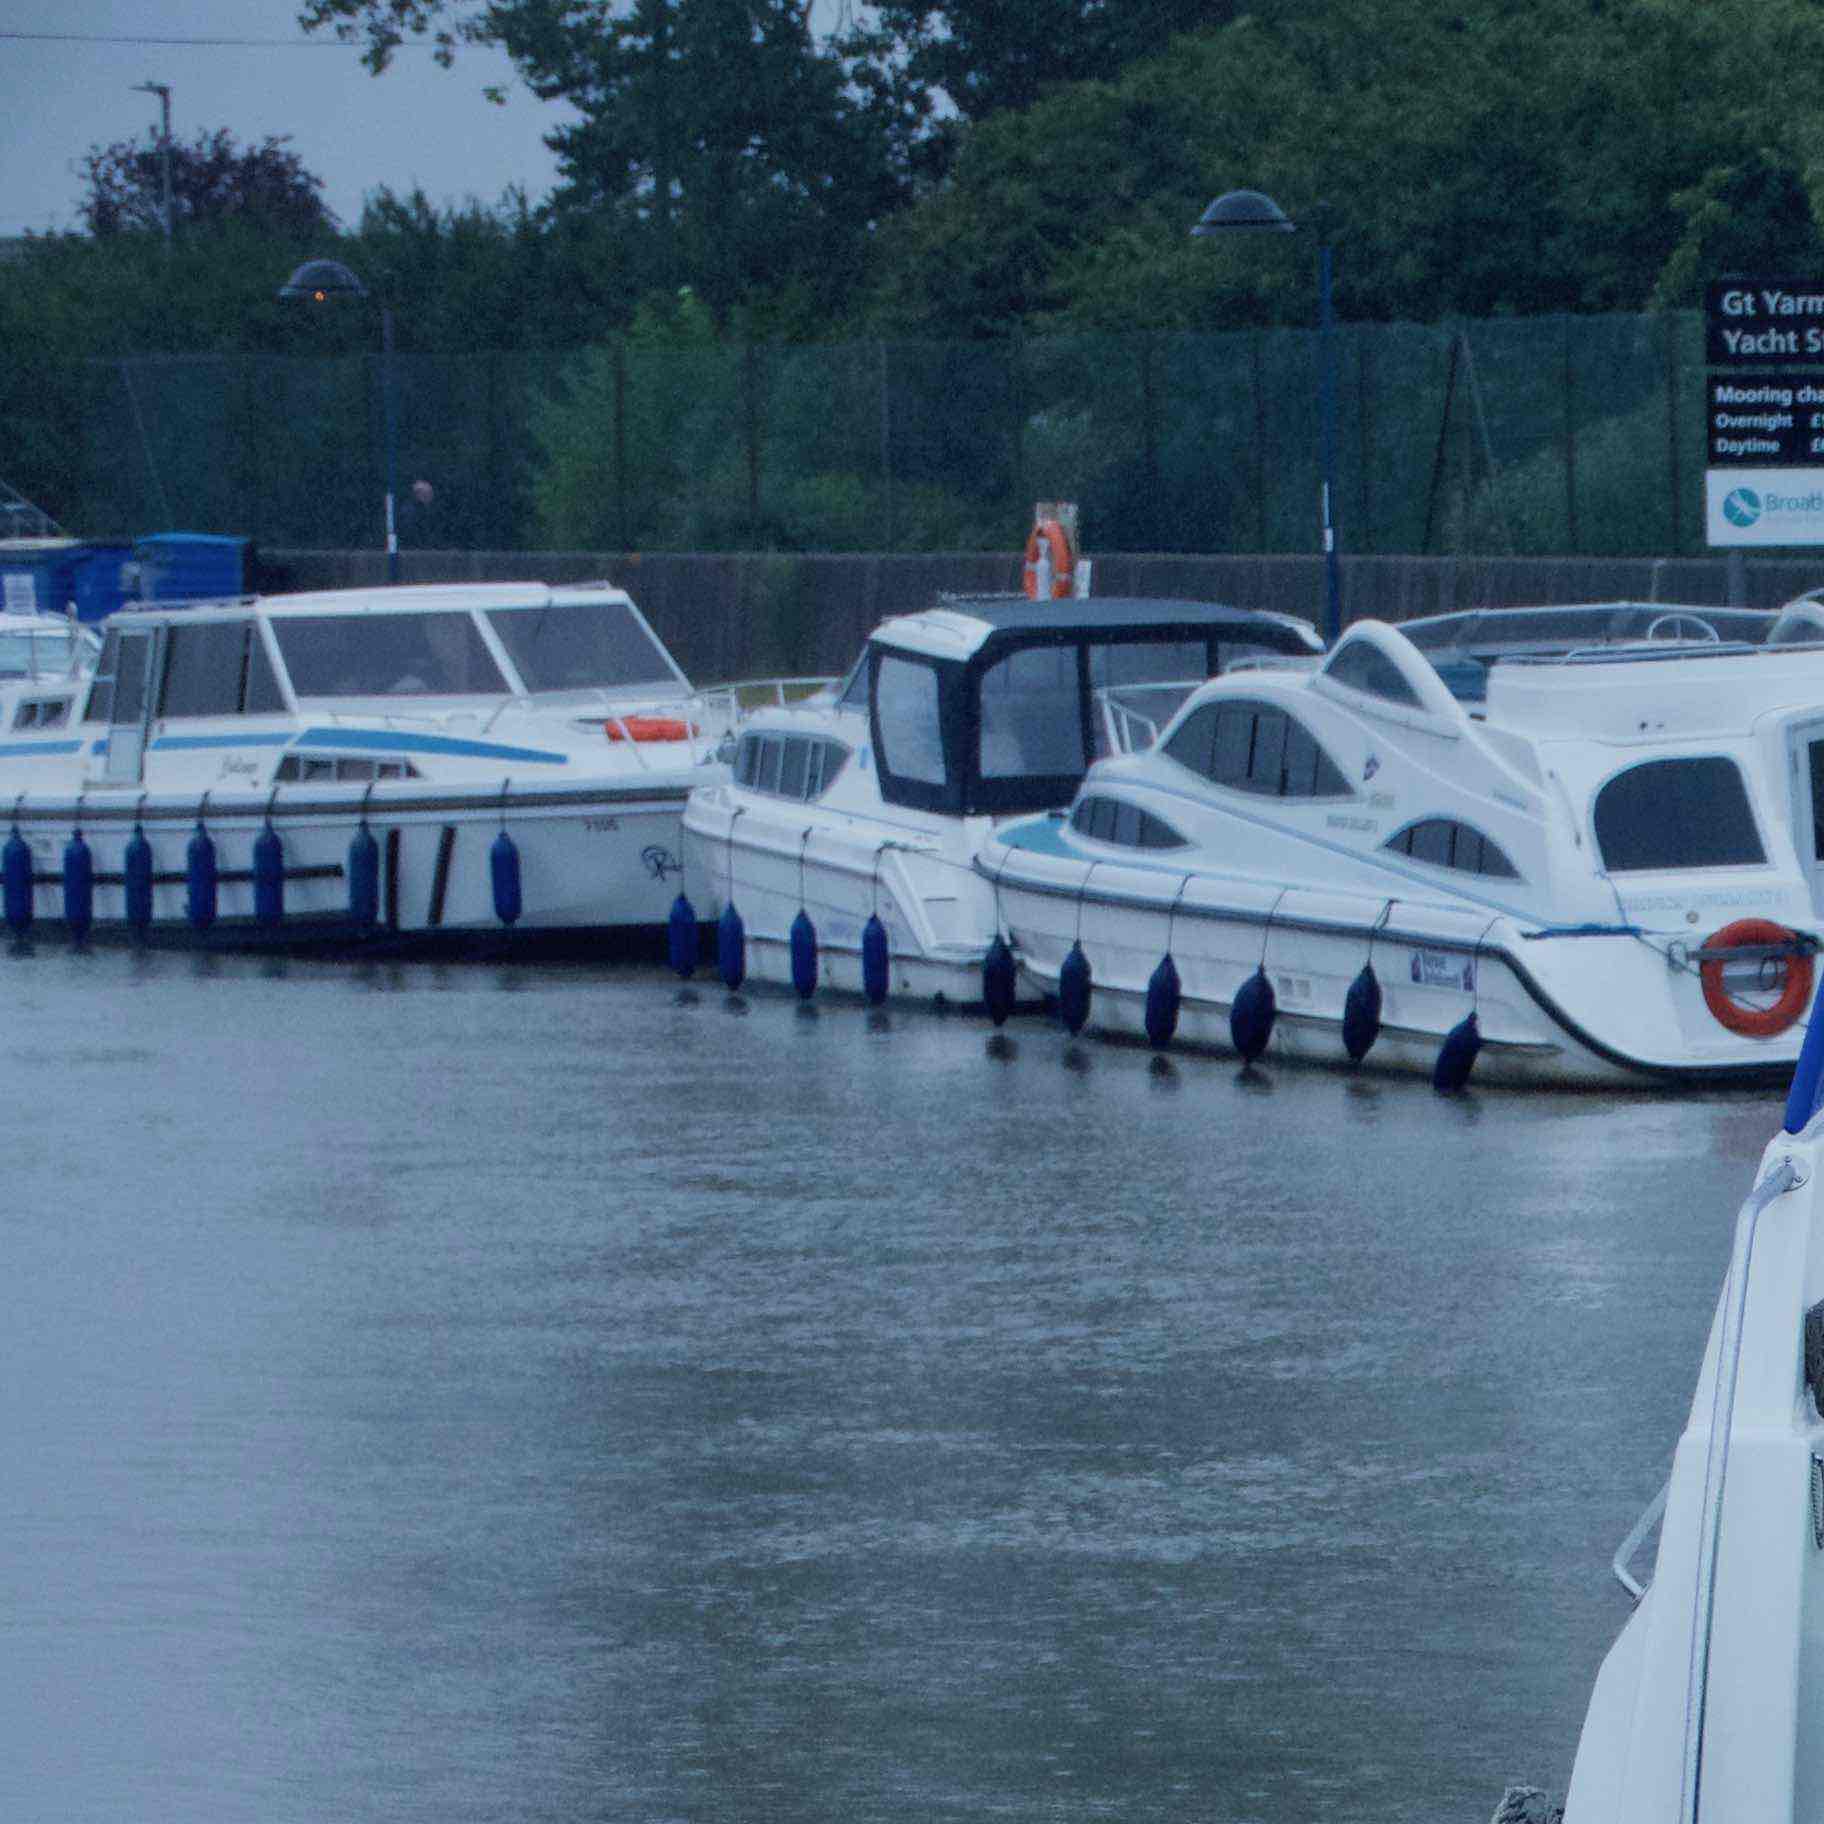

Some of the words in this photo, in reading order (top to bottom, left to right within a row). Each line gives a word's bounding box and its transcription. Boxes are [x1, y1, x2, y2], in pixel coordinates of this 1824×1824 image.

[1722, 290, 1756, 316] Gt
[1722, 328, 1800, 354] Yacht
[1715, 385, 1792, 406] Mooring
[1715, 413, 1793, 431] Overnight
[1715, 438, 1780, 456] Daytime
